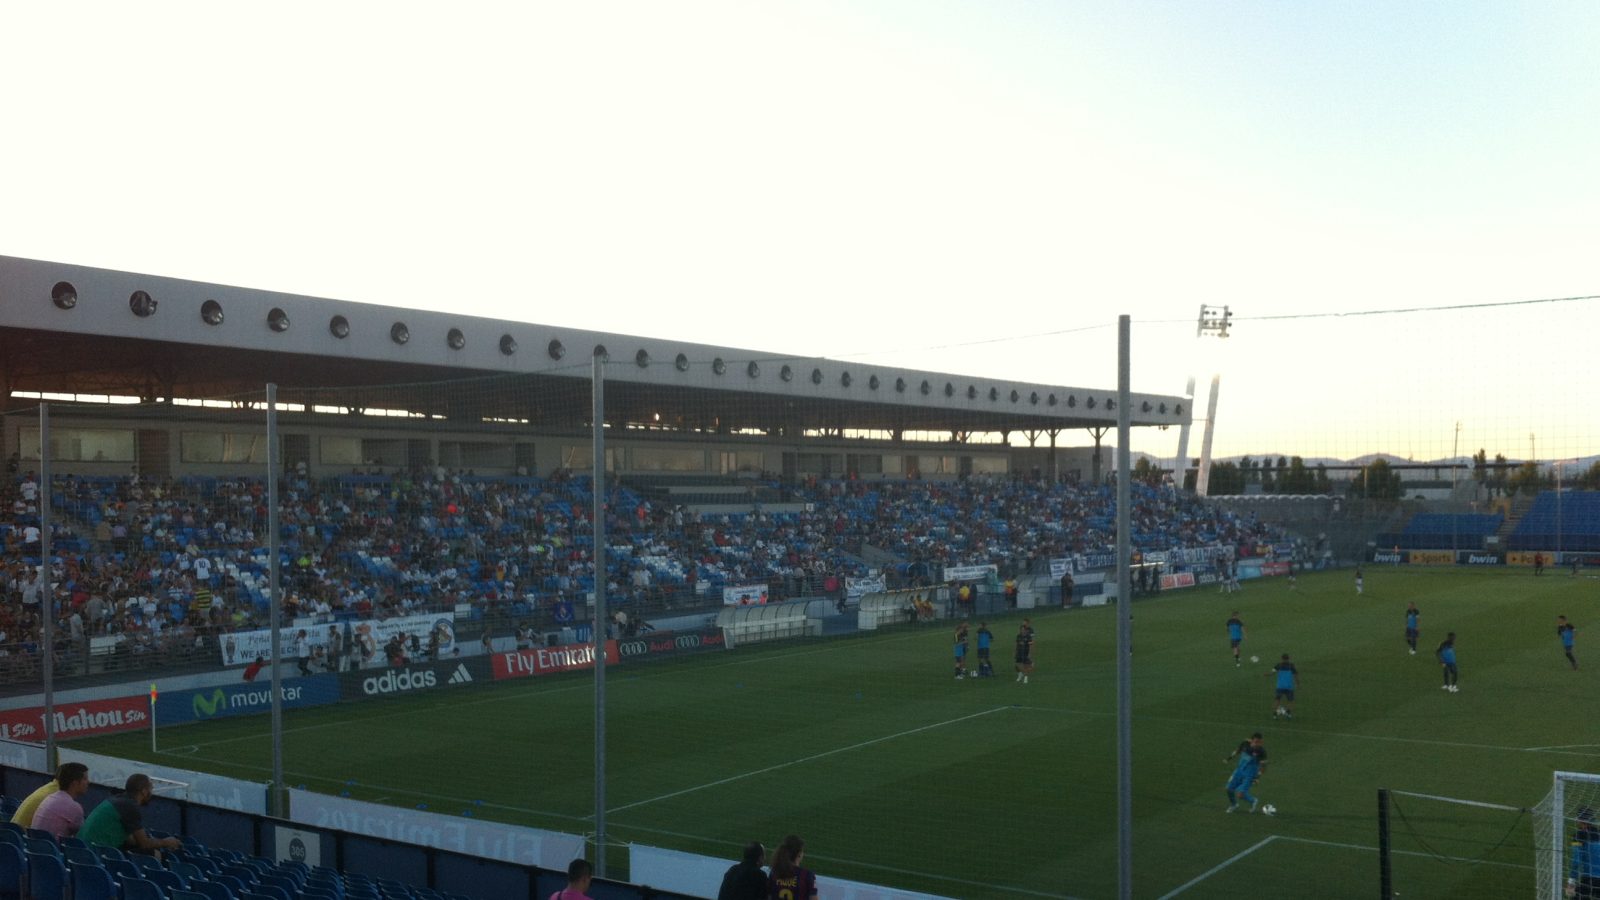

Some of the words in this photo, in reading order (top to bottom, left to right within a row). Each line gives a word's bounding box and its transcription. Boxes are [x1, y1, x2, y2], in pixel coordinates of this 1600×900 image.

[1373, 552, 1401, 563] bwin
[1421, 552, 1451, 564] Sports
[1468, 554, 1497, 564] bwin
[1520, 553, 1549, 564] Por
[198, 560, 206, 569] 10
[650, 640, 674, 652] Audi
[702, 635, 723, 645] Audi
[240, 650, 254, 659] WE
[255, 648, 270, 657] ARE
[505, 651, 534, 674] Fly
[363, 667, 437, 695] adidas
[231, 686, 303, 708] movitar
[40, 708, 124, 735] Mahou
[291, 845, 305, 857] 305
